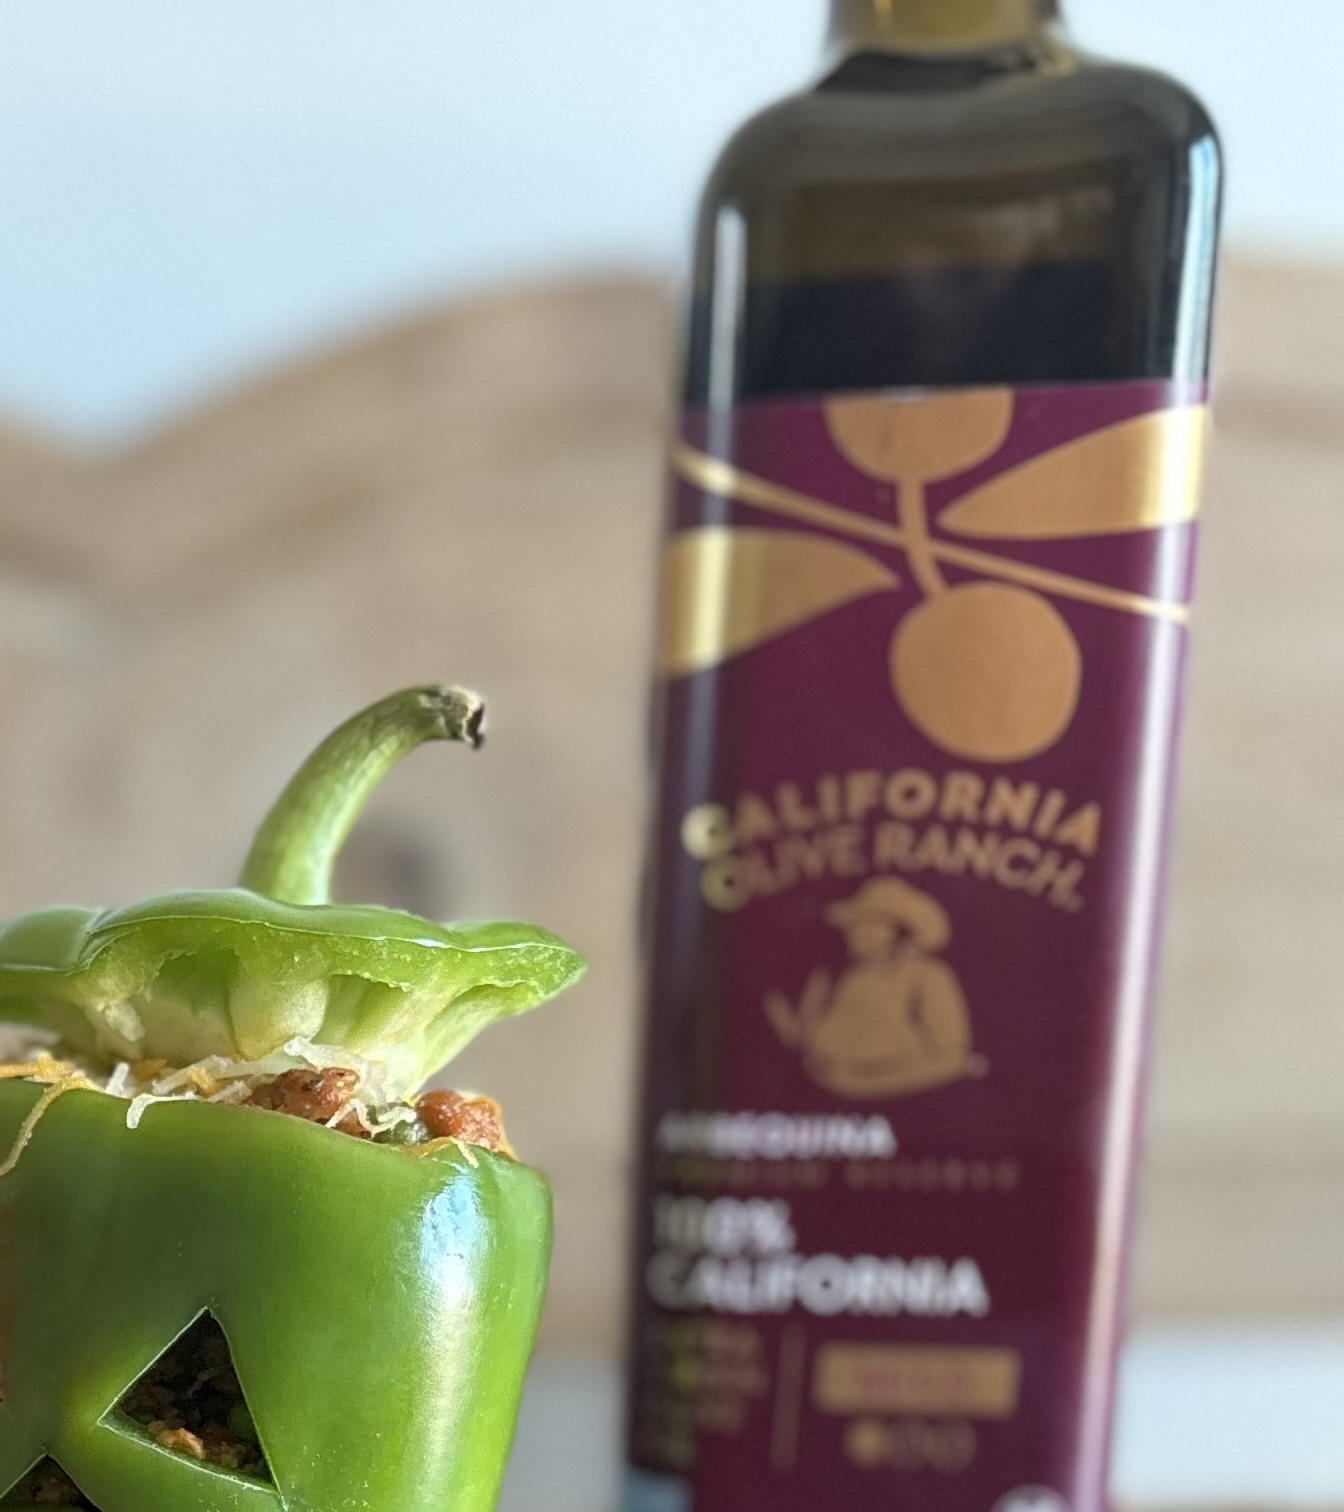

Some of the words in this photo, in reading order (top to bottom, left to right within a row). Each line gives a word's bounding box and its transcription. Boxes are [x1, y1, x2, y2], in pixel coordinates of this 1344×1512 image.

[680, 768, 1102, 862] CALIFORNIA
[700, 822, 866, 912] OLIVE
[645, 1248, 991, 1318] CALIFORNIA
